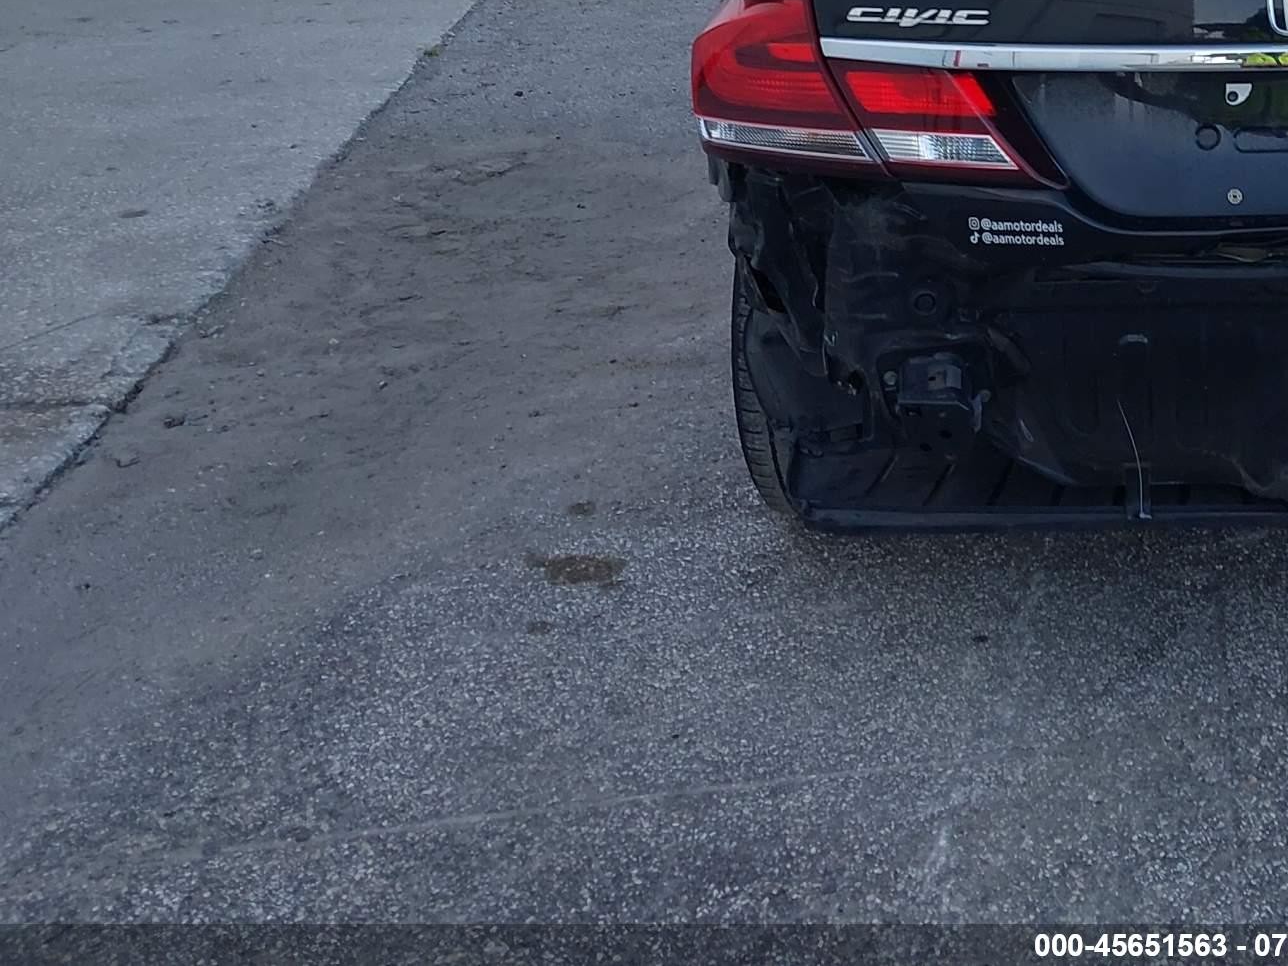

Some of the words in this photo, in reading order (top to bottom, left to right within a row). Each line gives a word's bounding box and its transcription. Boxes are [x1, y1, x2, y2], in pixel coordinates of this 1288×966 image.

[847, 7, 990, 27] CIVIC
[981, 218, 1063, 233] @aamotordeals
[982, 232, 1065, 245] @aamotordeals
